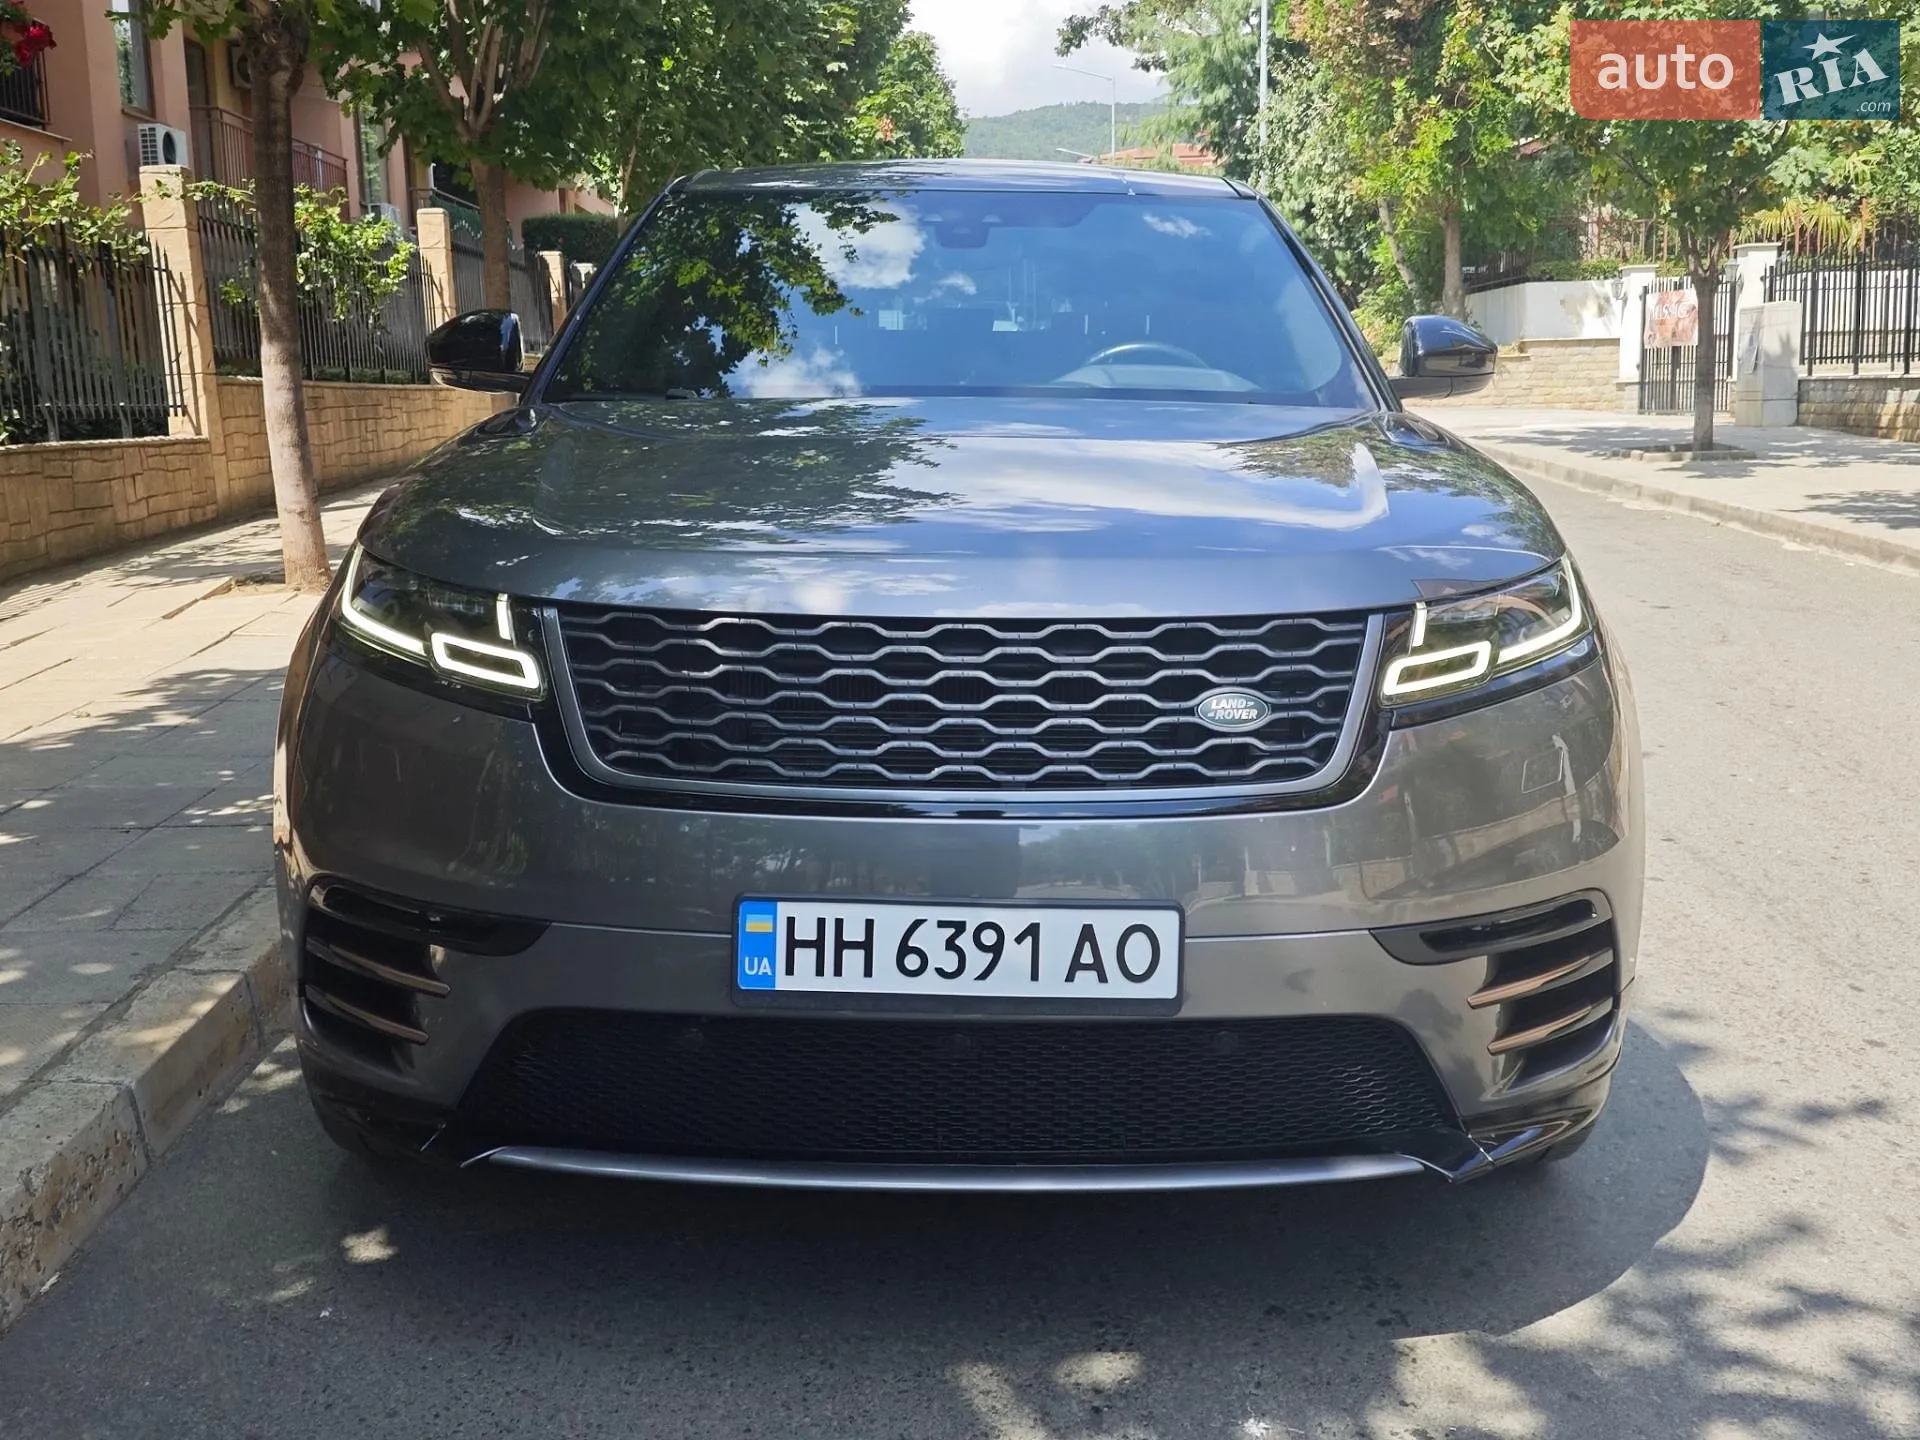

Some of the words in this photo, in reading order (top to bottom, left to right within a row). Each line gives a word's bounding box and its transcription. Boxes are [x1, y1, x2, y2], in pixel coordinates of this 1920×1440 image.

[1211, 698, 1247, 709] LAND
[1215, 708, 1258, 720] ROVER
[785, 917, 875, 977] HH
[895, 919, 1041, 982] 6391
[1064, 923, 1160, 984] AO
[744, 958, 772, 976] UA
